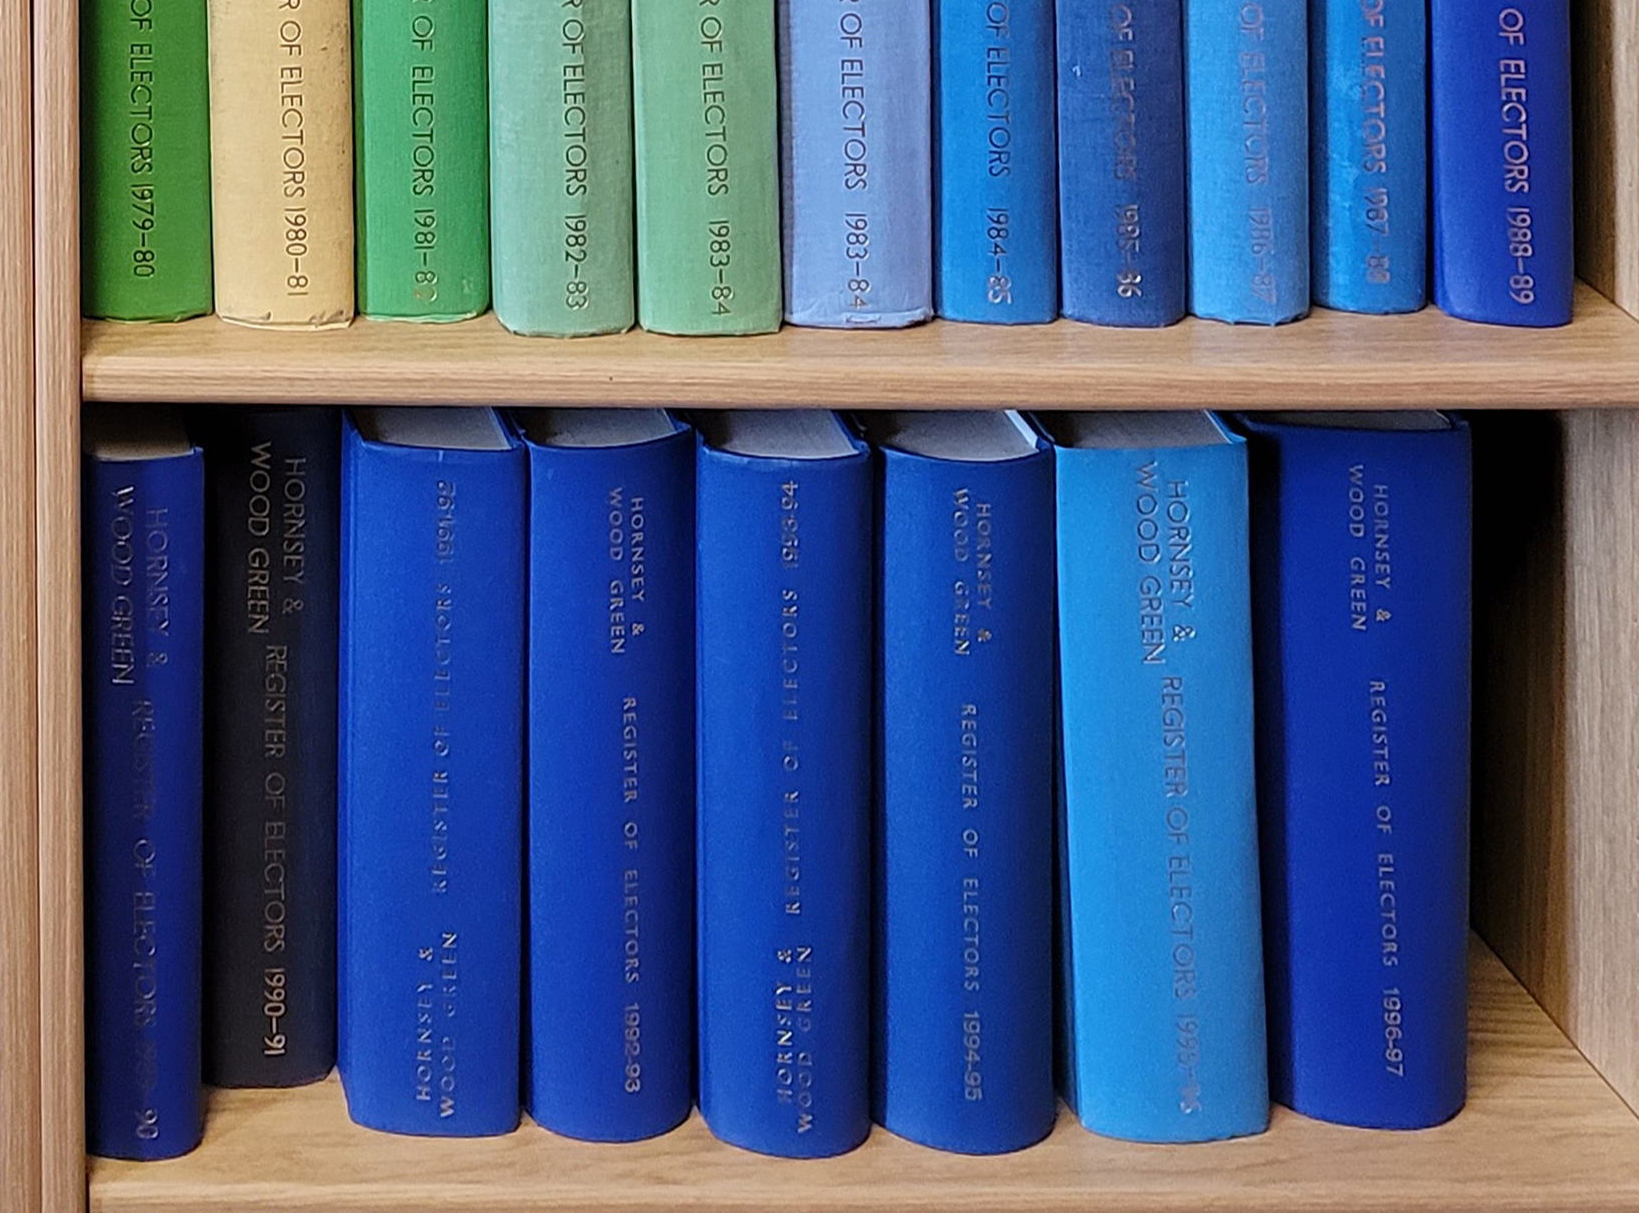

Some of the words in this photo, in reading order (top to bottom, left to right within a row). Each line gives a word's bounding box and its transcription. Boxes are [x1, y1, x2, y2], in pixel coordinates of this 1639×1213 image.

[278, 20, 303, 56] OF
[410, 14, 434, 52] OF
[561, 19, 586, 55] OF
[698, 16, 723, 54] OF
[839, 12, 863, 49] OF
[984, 2, 1010, 37] OF
[1498, 8, 1525, 45] OF
[129, 43, 154, 175] ELECTORS
[280, 66, 306, 199] ELECTORS
[410, 66, 435, 196] ELECTORS
[562, 64, 588, 196] ELECTORS
[701, 63, 729, 197] ELECTORS
[840, 58, 868, 191] ELECTORS
[986, 47, 1011, 178] ELECTORS
[1499, 59, 1530, 194] ELECTORS
[131, 185, 155, 278] 1979-80
[283, 207, 310, 296] 1980-81
[563, 214, 589, 311] 1982-83
[707, 218, 735, 317] 1983-84
[844, 212, 871, 309] 1983-84
[986, 207, 1013, 305] 1984-85
[1506, 206, 1536, 305] 1988-89
[247, 440, 272, 537] WOOD
[282, 458, 307, 587] HORNSEY
[608, 486, 625, 562] WOOD
[952, 487, 970, 562] WOOD
[1348, 463, 1365, 538] WOOD
[629, 497, 645, 603] HORNSEY
[975, 503, 992, 611] HORNSEY
[1373, 483, 1392, 588] HORNSEY
[246, 547, 270, 634] GREEN
[282, 598, 304, 615] &
[609, 579, 626, 655] GREEN
[630, 622, 645, 637] &
[953, 580, 971, 657] GREEN
[1349, 556, 1368, 631] GREEN
[1374, 608, 1392, 623] &
[263, 645, 289, 759] REGISTER
[1368, 680, 1391, 787] REGISTER
[263, 772, 286, 811] OF
[621, 697, 639, 804] REGISTER
[960, 703, 978, 809] REGISTER
[622, 821, 639, 852] OF
[962, 828, 979, 858] OF
[1375, 804, 1393, 835] OF
[263, 821, 286, 953] ELECTORS
[623, 869, 640, 984] ELECTORS
[1377, 852, 1399, 967] ELECTORS
[962, 878, 981, 992] ELECTORS
[262, 967, 287, 1056] 1990-91
[623, 1002, 641, 1093] 1992-93
[962, 1010, 983, 1101] 1994-95
[1382, 987, 1406, 1078] 1996-97
